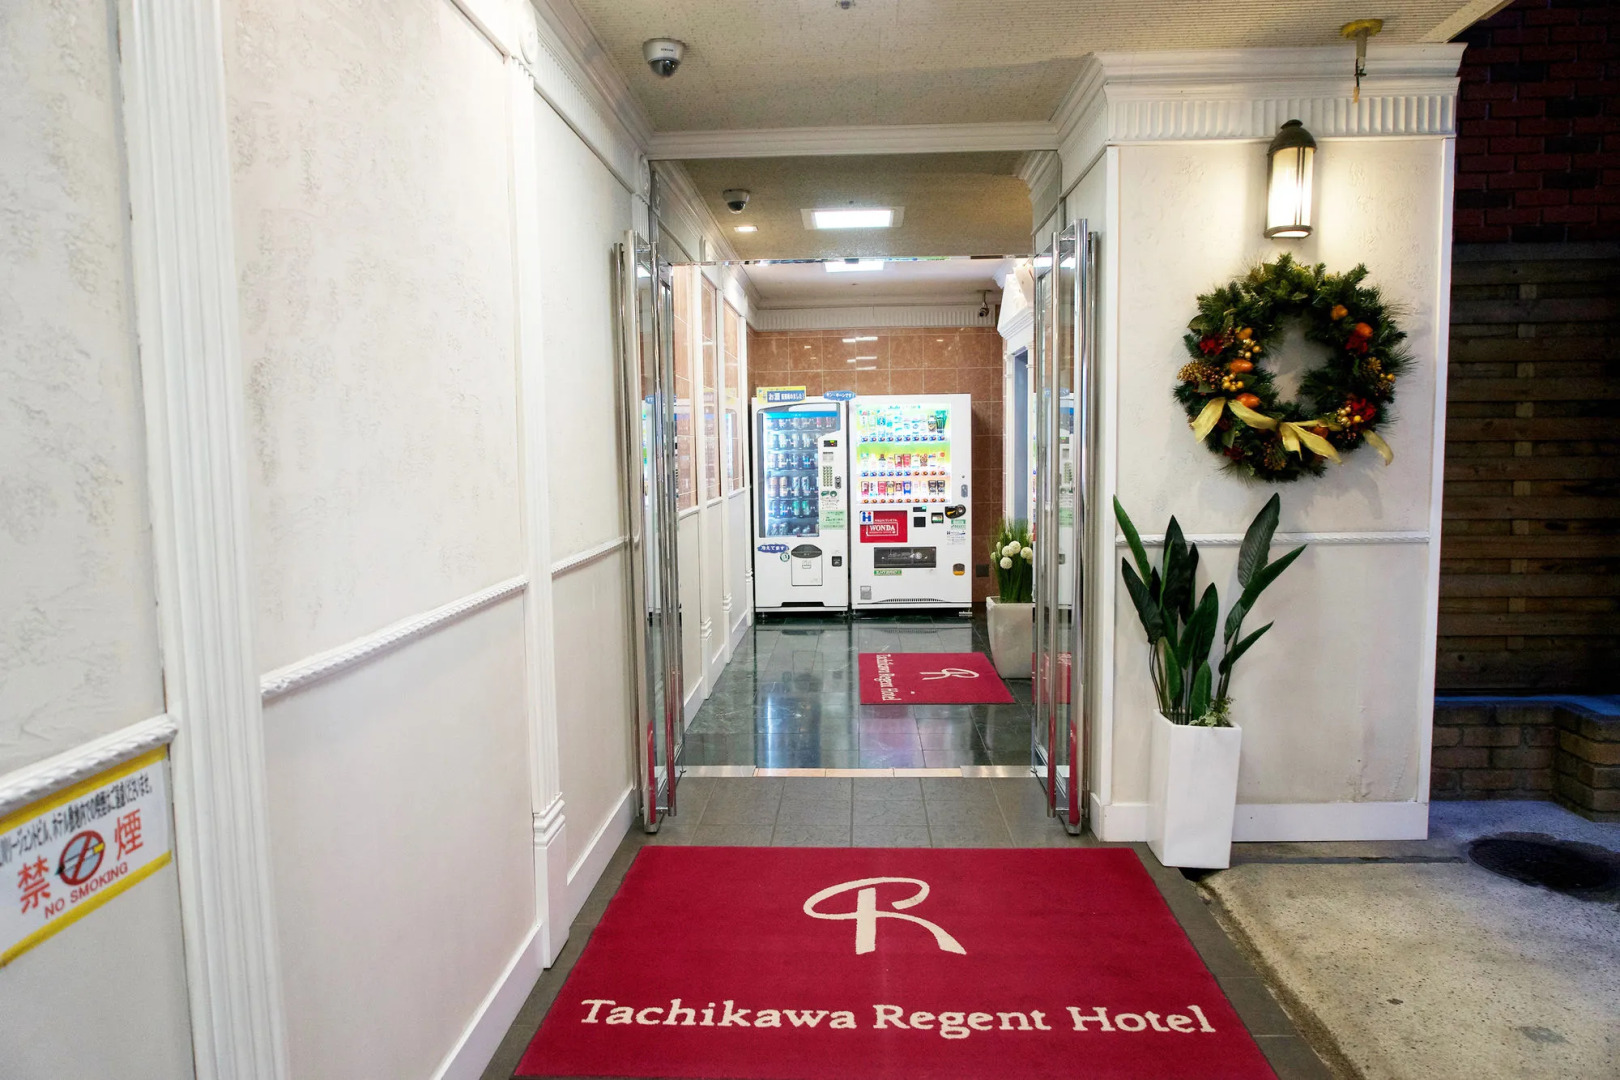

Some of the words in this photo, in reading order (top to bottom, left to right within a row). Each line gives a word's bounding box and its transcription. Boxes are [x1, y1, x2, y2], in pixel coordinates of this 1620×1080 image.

[869, 524, 896, 532] WONDA
[17, 855, 51, 914] 禁
[114, 809, 144, 860] 煙
[44, 898, 65, 918] NO
[70, 863, 129, 904] SMOKING
[803, 876, 968, 956] R
[580, 998, 858, 1031] Tachikawa
[872, 1003, 1053, 1040] Regent
[1069, 1003, 1216, 1035] Hotel
